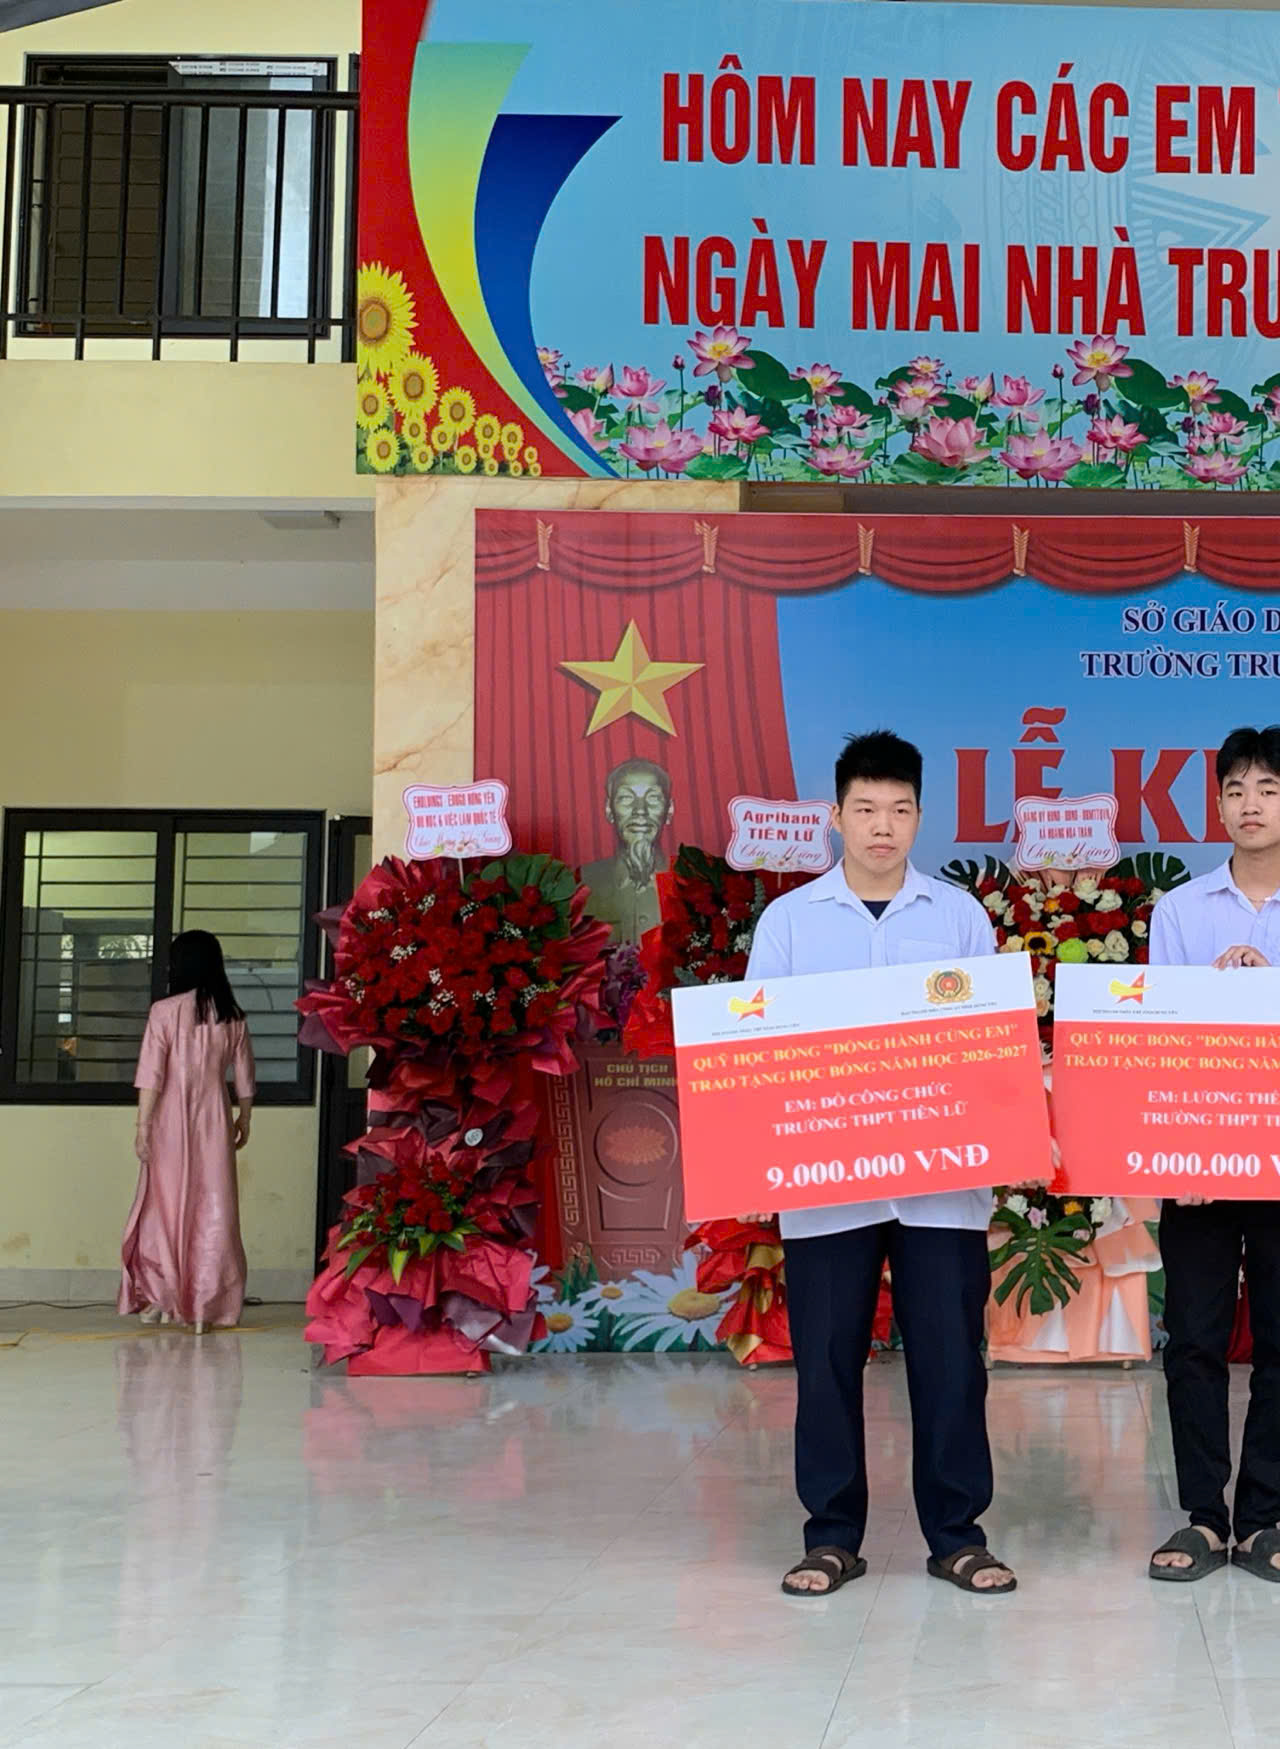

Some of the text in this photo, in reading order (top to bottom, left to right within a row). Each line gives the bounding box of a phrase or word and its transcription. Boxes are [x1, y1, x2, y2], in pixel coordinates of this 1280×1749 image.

[662, 55, 816, 166] HÔM
[842, 78, 972, 169] NAY
[997, 63, 1130, 174] CÁC
[1155, 85, 1256, 176] EM
[644, 218, 827, 329] NGÀY
[852, 241, 980, 332] MAI
[1006, 226, 1146, 337] NHÀ
[1124, 602, 1165, 632] SỞ
[1174, 603, 1255, 632] GIÁO
[1081, 646, 1218, 677] TRƯỜNG
[743, 810, 821, 825] Agribank
[748, 826, 815, 842] TIÊN LỮ
[693, 1050, 729, 1072] QUỸ
[734, 1047, 771, 1068] HỌC
[884, 1032, 932, 1050] HÀNH
[935, 1026, 982, 1044] CÙNG
[1109, 1033, 1143, 1049] HỌC
[606, 1060, 668, 1075] CHỦ TỊCH
[688, 1076, 736, 1093] TRAO
[740, 1069, 786, 1090] TẶNG
[789, 1065, 826, 1085] HỌC
[880, 1053, 919, 1073] NĂM
[921, 1050, 959, 1070] HỌC
[961, 1044, 1028, 1063] 2026-2027
[1064, 1054, 1108, 1068] TRAO
[1111, 1053, 1156, 1072] TẶNG
[1160, 1056, 1196, 1073] HỌC
[594, 1075, 612, 1087] HỒ
[616, 1075, 639, 1087] CHÍ
[784, 1098, 816, 1114] EM:
[849, 1087, 899, 1107] CÔNG
[1147, 1090, 1179, 1104] EM:
[1183, 1089, 1242, 1105] LƯƠNG
[772, 1116, 847, 1137] TRƯỜNG
[850, 1111, 895, 1129] THPT
[898, 1104, 940, 1123] TIÊN
[1141, 1109, 1212, 1127] TRƯỜNG
[1216, 1112, 1260, 1127] THPT
[766, 1143, 990, 1191] 9.000.000 VNĐ
[1126, 1151, 1260, 1177] 9.000.000
